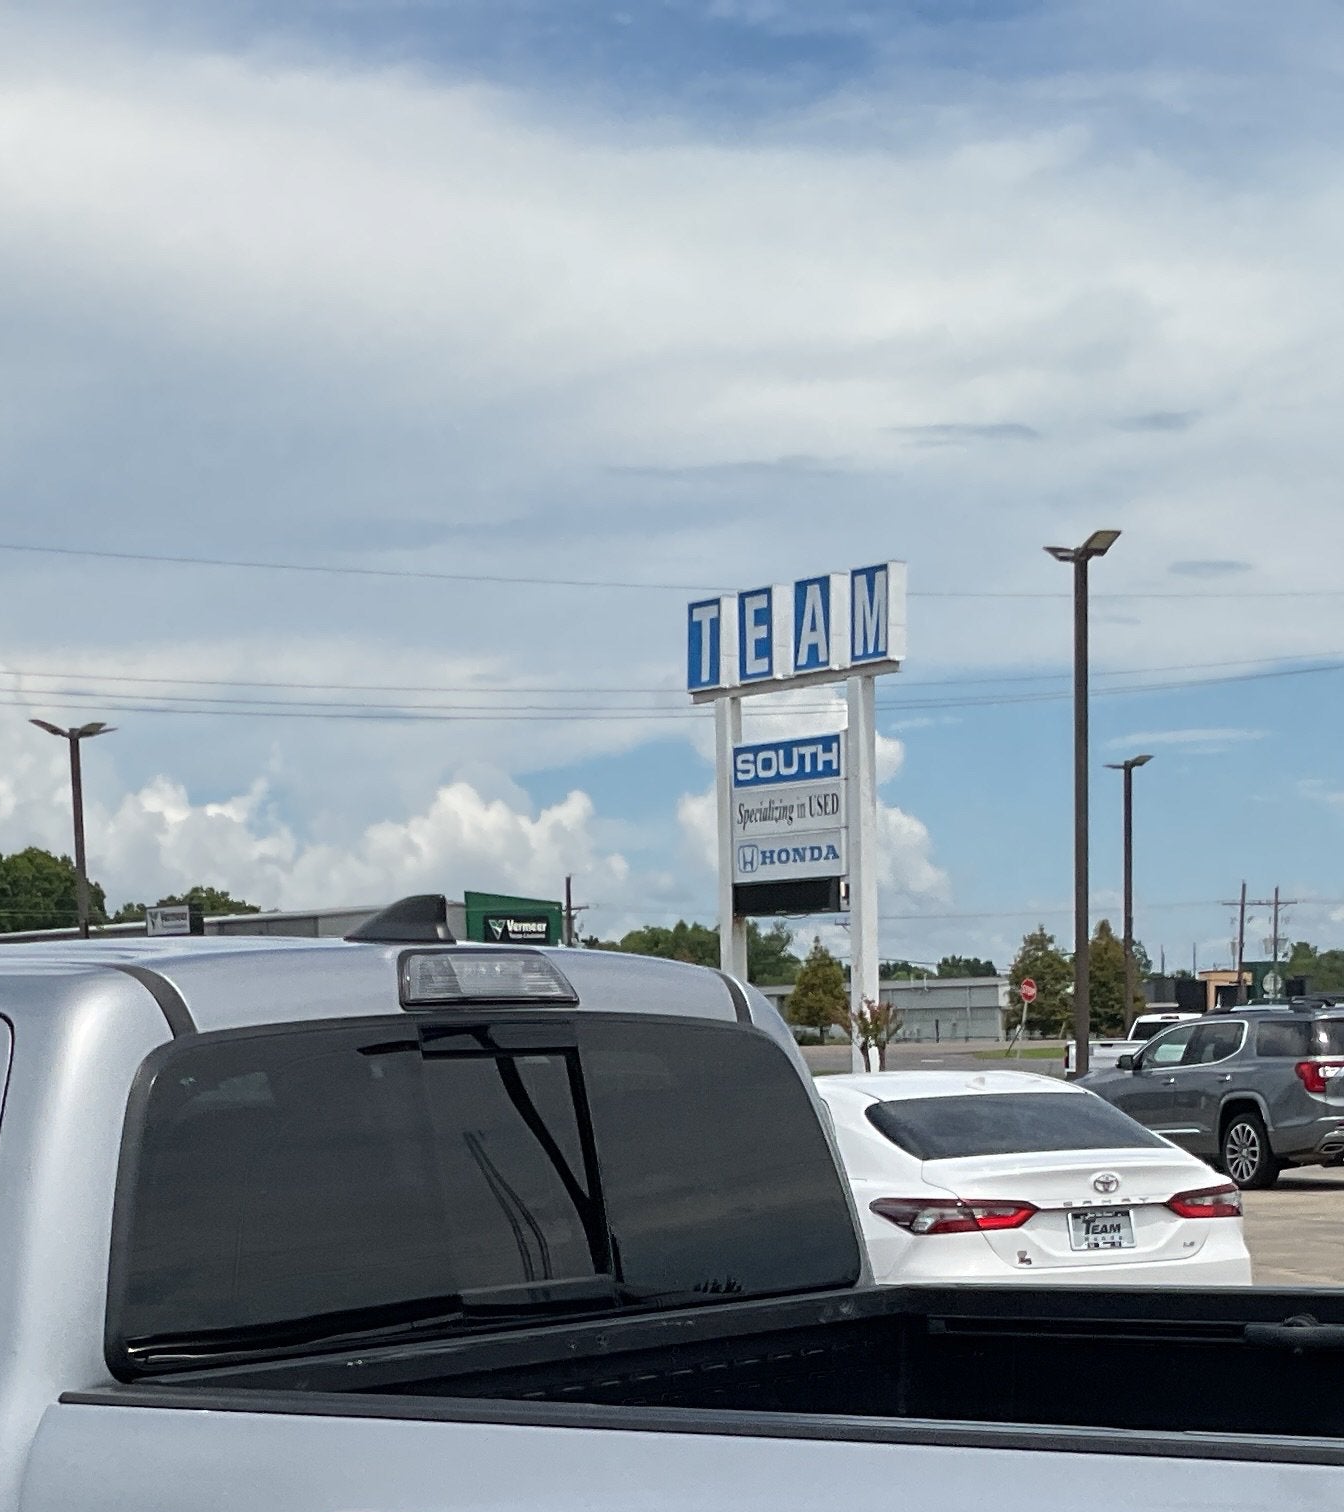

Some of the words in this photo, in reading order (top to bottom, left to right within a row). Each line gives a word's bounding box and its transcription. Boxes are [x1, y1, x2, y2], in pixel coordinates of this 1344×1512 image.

[692, 570, 887, 683] TEAM
[736, 742, 839, 781] SOUTH
[737, 799, 795, 831] Specializing
[797, 797, 806, 819] in
[809, 793, 839, 818] USED
[760, 845, 840, 866] HONDA
[506, 919, 547, 932] Vermeer
